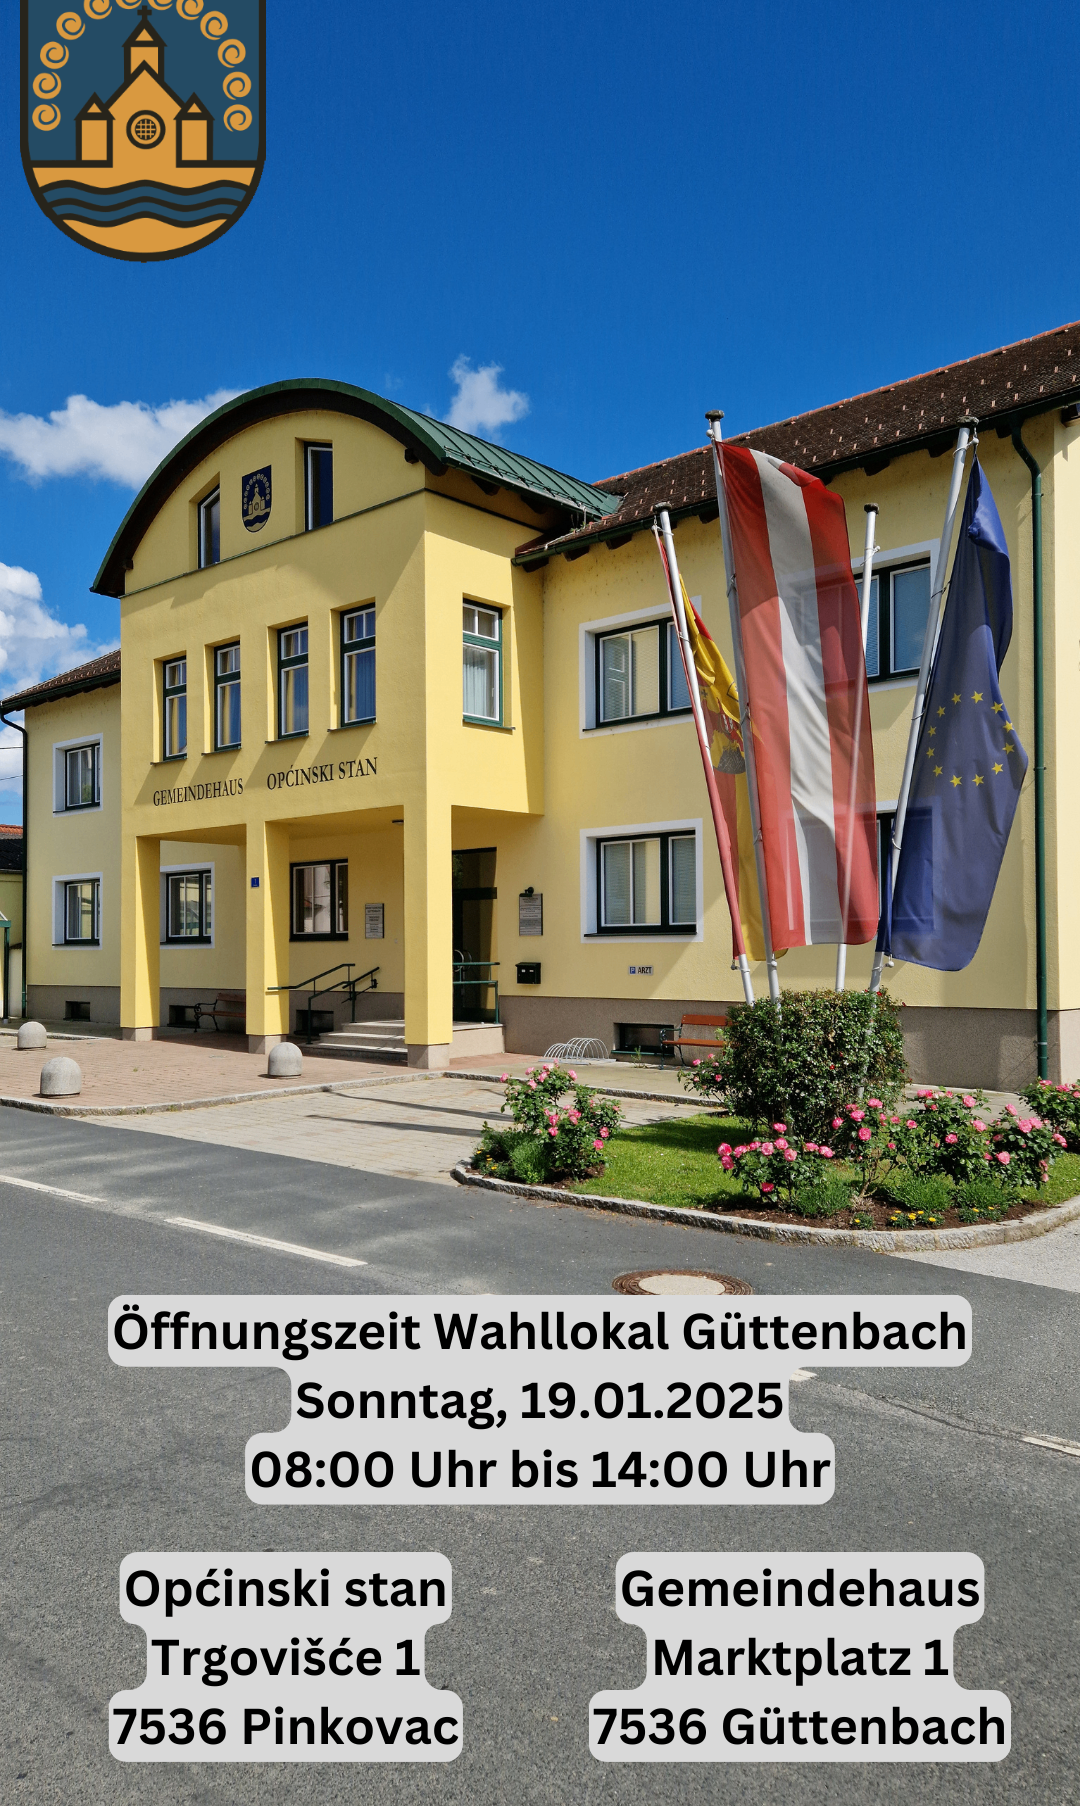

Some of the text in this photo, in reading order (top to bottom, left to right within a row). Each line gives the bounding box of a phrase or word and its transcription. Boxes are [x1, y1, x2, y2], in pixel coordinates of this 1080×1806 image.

[266, 757, 378, 791] OPĆINSKI STAN
[153, 778, 244, 806] GEMEINDEHAUS
[637, 966, 652, 974] ARZT
